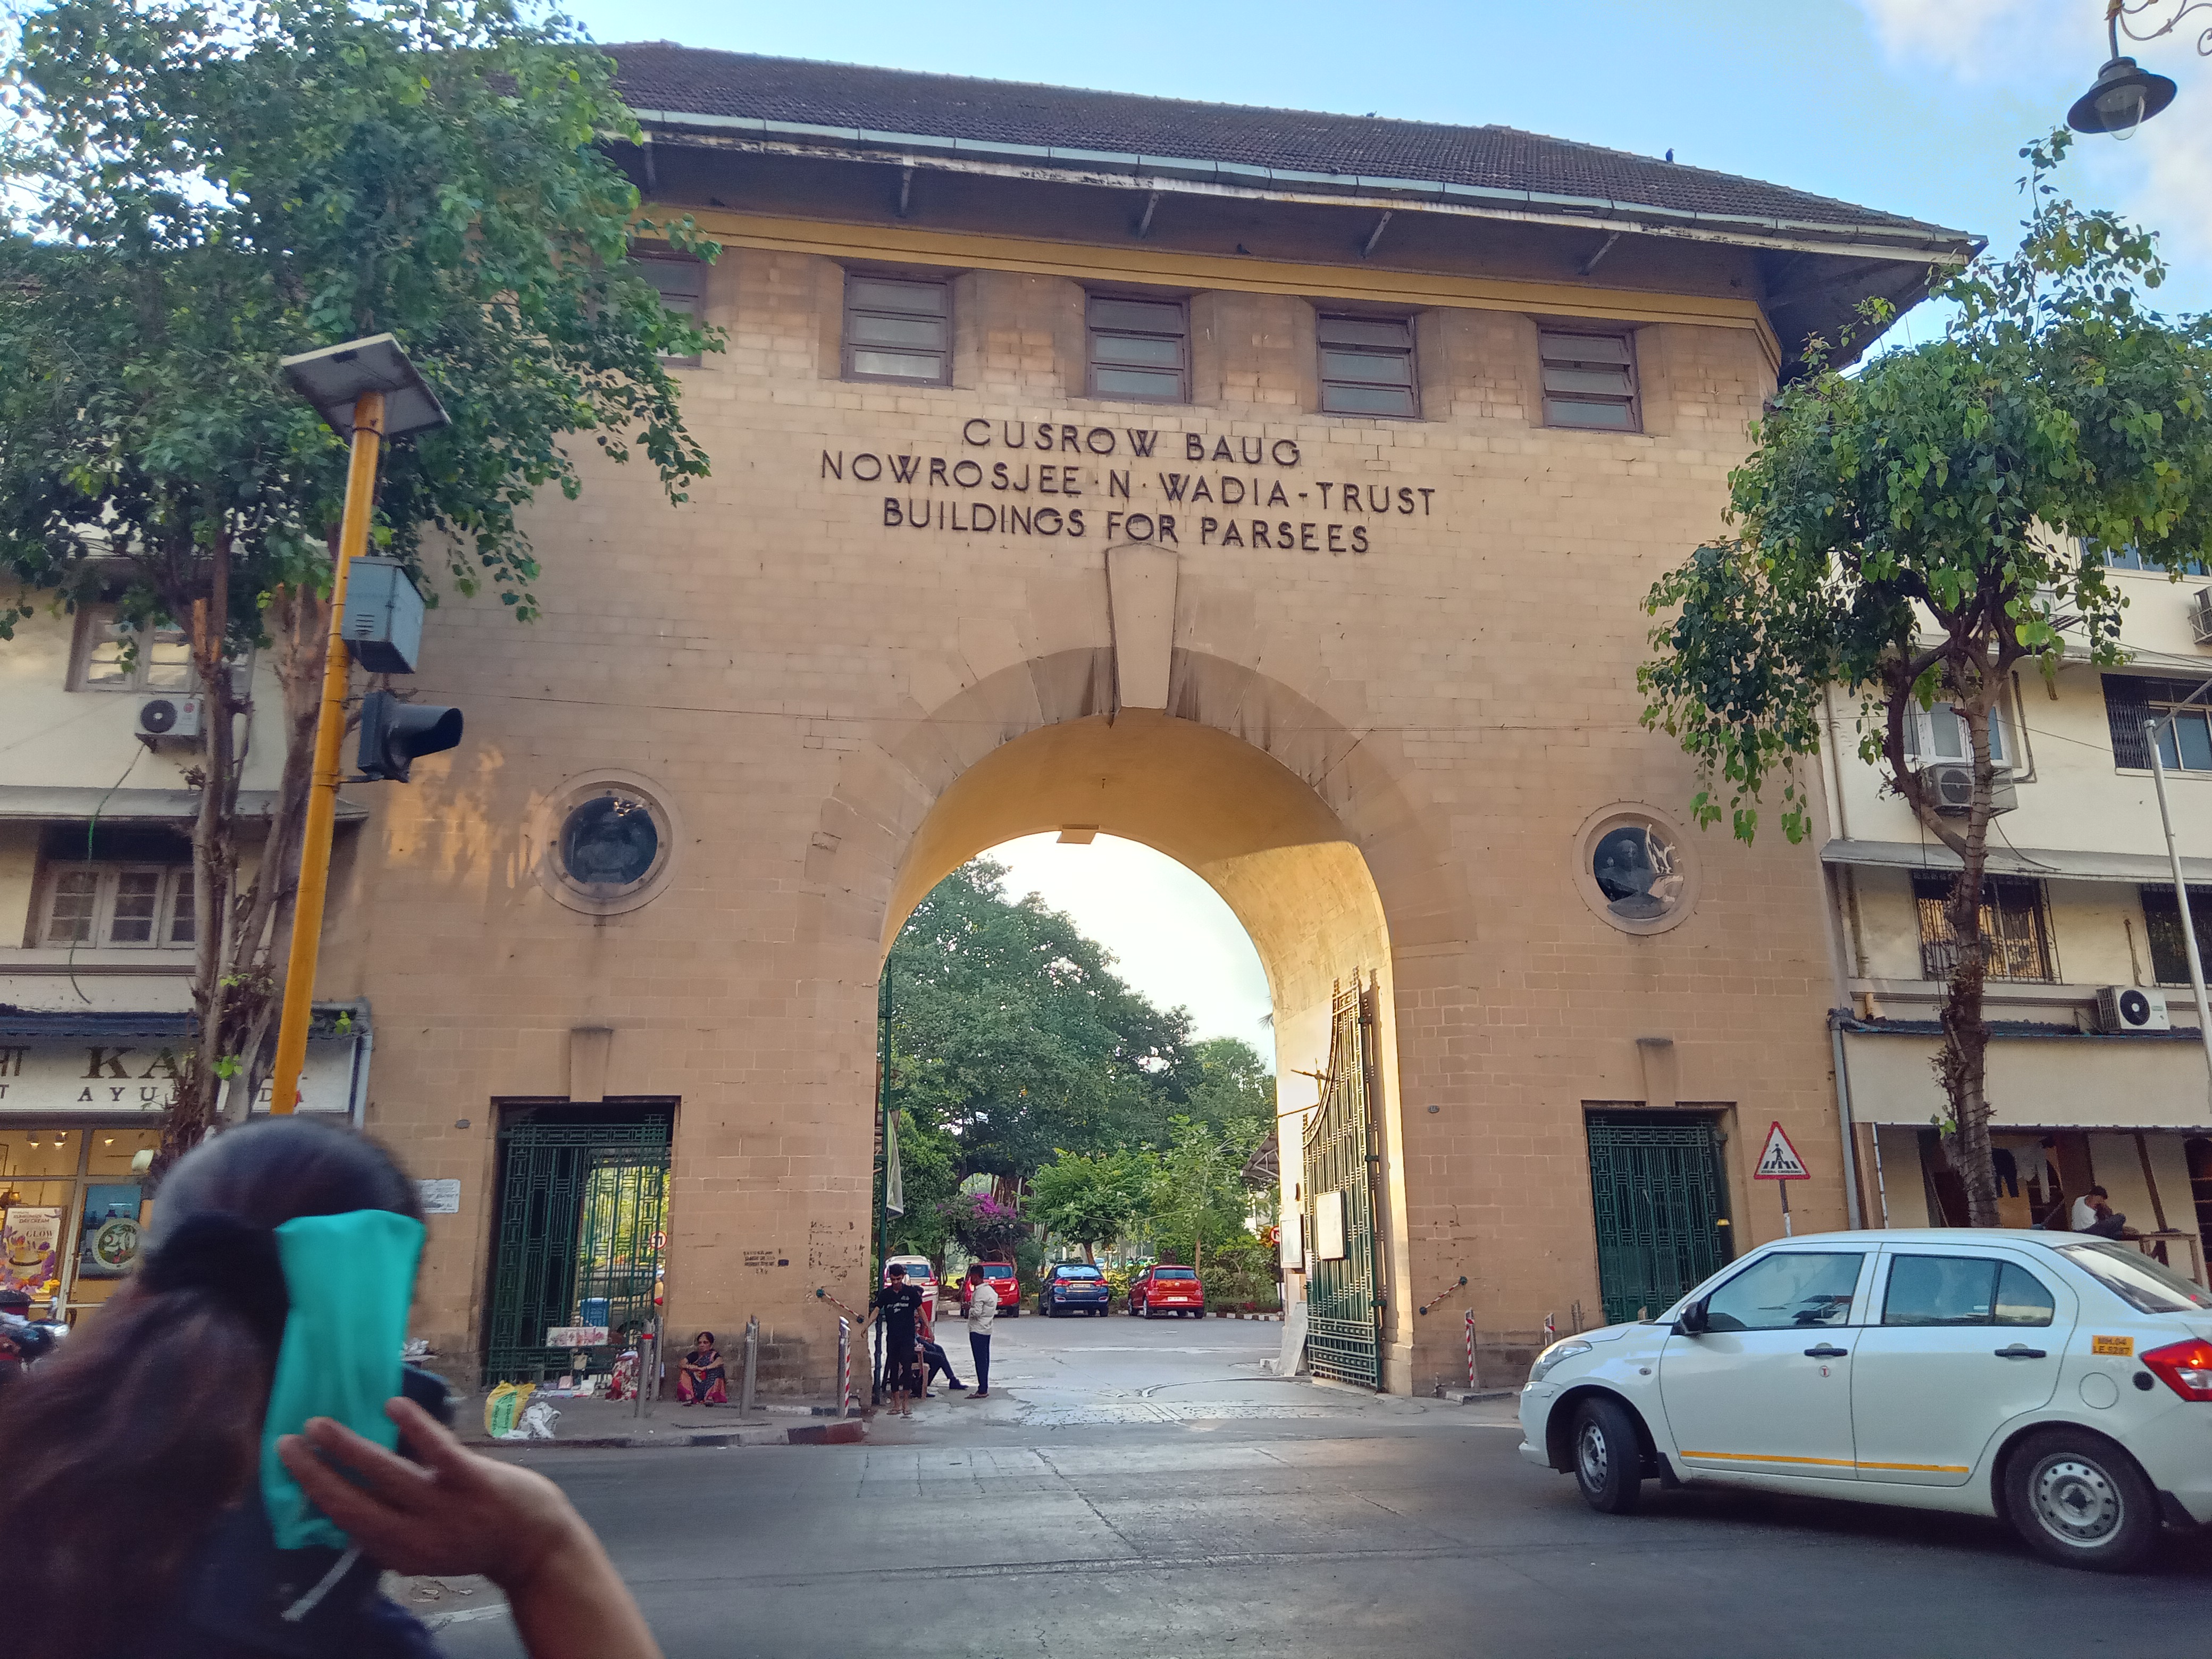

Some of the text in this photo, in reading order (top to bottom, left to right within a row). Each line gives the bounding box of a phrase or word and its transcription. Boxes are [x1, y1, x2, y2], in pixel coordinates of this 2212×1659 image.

[963, 418, 1300, 466] CUSROW BAUG
[884, 497, 1369, 552] BUILDINGS FOR PARSEES
